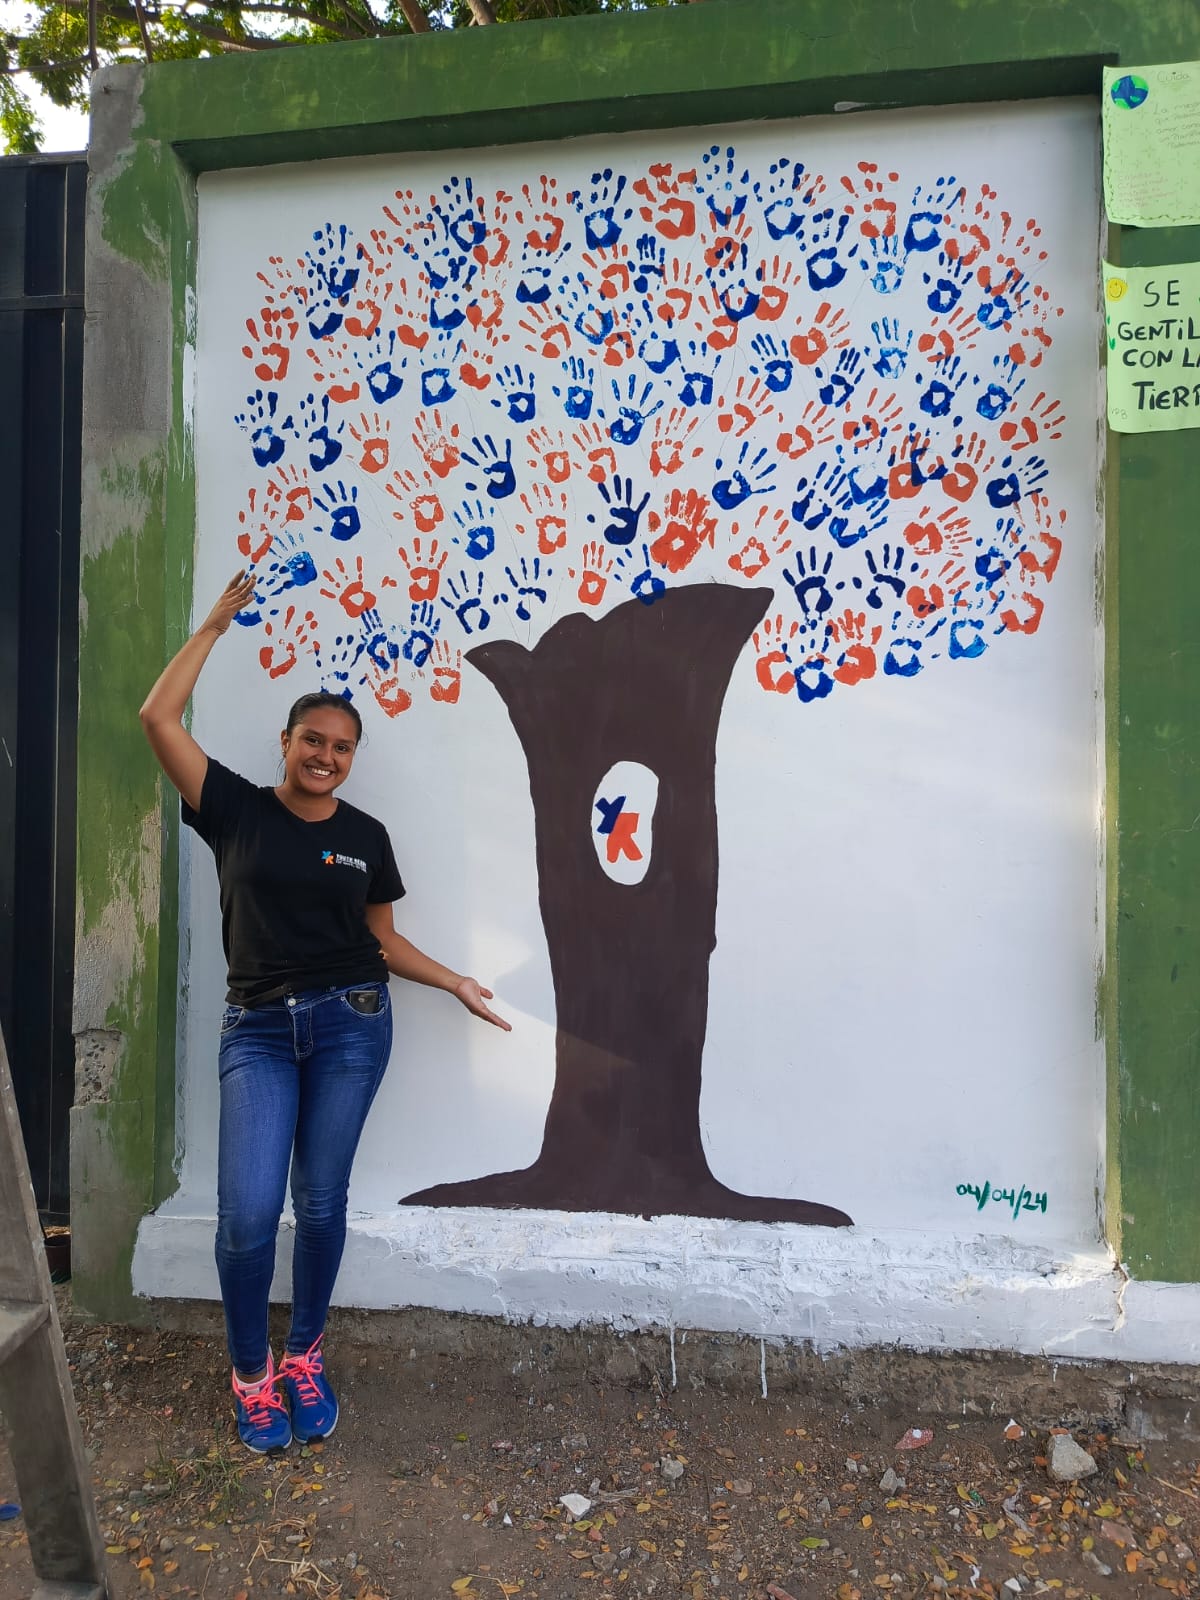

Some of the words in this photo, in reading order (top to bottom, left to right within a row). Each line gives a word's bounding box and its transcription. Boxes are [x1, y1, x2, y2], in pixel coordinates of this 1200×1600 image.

[1144, 280, 1180, 307] SE
[1123, 349, 1173, 368] CON
[1182, 347, 1200, 368] L
[956, 1180, 1047, 1221] 04/04/24
